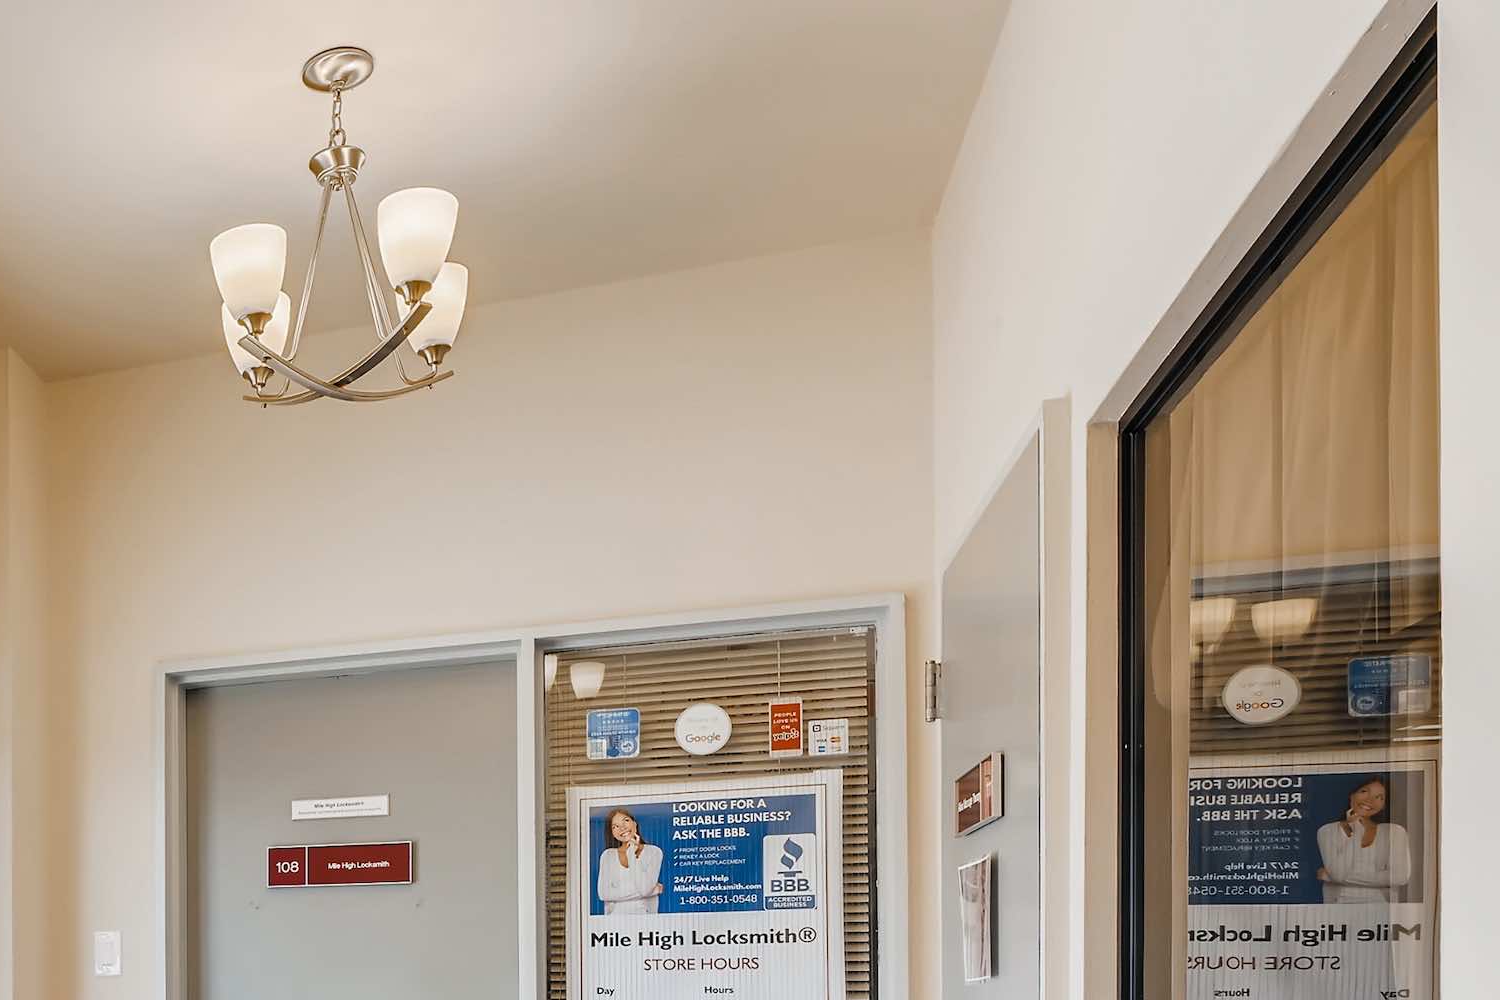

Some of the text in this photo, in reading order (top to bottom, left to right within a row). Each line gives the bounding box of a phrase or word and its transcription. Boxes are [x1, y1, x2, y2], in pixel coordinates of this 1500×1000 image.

[685, 731, 721, 744] Google
[673, 798, 767, 813] LOOKING FOR A
[673, 811, 792, 827] RELIABLE BUSINESS?
[673, 827, 750, 841] ASK THE BBB.
[275, 860, 390, 873] 108 Mile High Locksmith
[673, 874, 730, 884] 24/7 Live Help
[673, 882, 762, 893] MileHighLocksmith.com
[770, 879, 809, 893] BBB
[680, 894, 758, 905] 1-800-351-0548
[768, 895, 812, 903] ACCREDITED
[590, 931, 632, 948] Mile
[638, 931, 684, 950] High
[643, 957, 760, 971] STORE HOURS
[596, 986, 735, 996] Day Hours
